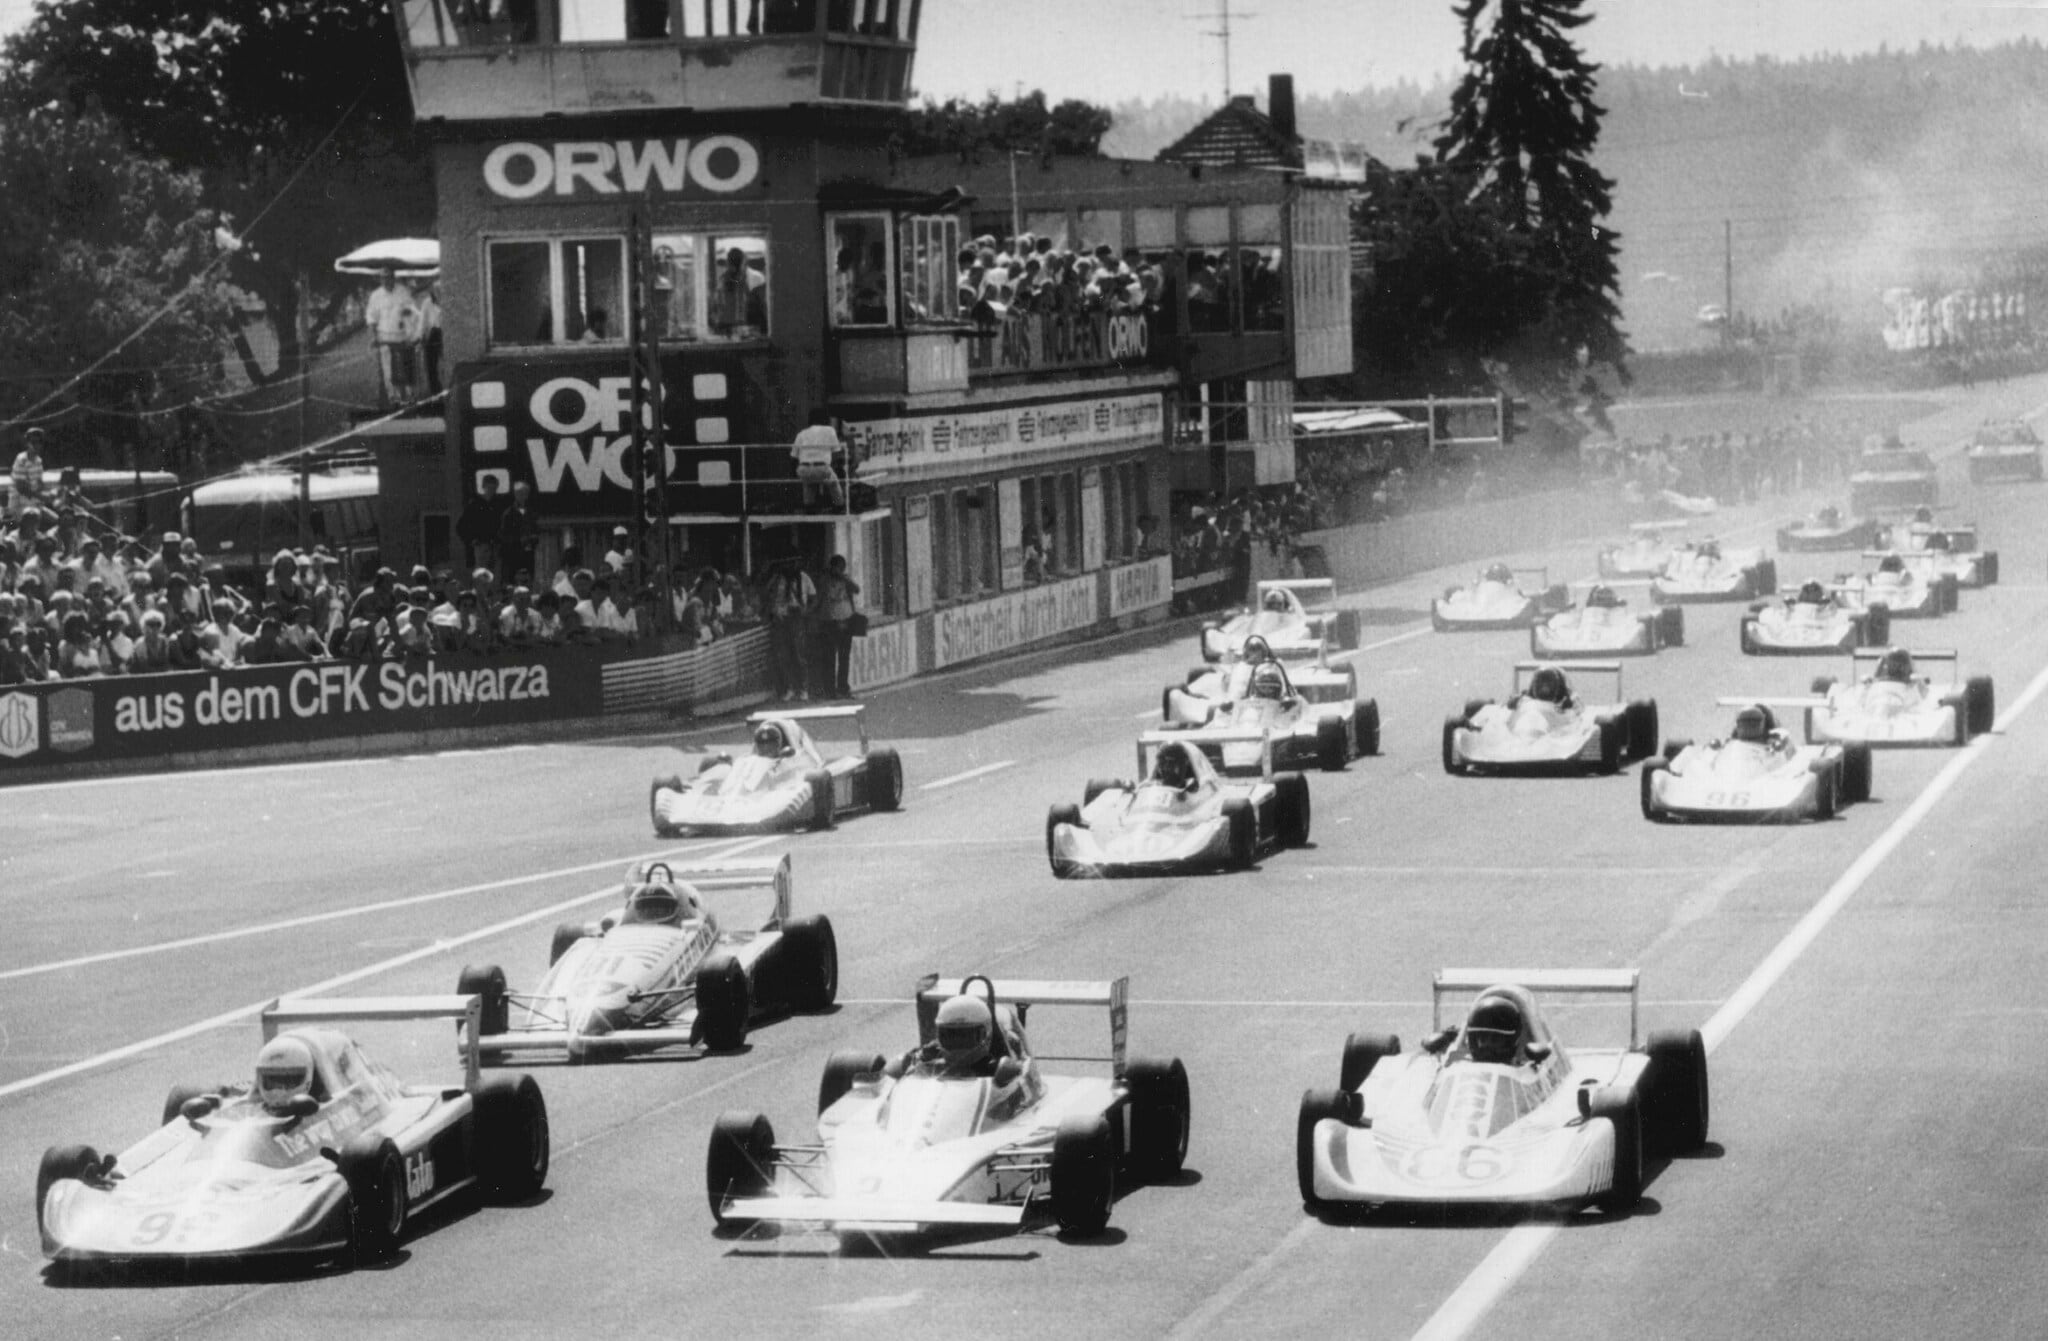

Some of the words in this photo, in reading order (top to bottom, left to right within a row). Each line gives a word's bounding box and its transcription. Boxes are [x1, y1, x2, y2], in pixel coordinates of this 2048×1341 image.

[483, 135, 759, 199] ORWO
[1108, 314, 1148, 360] ORWO
[115, 688, 185, 733] aus
[195, 676, 281, 726] dem
[289, 664, 370, 718] CFK
[378, 660, 549, 711] Schwarza
